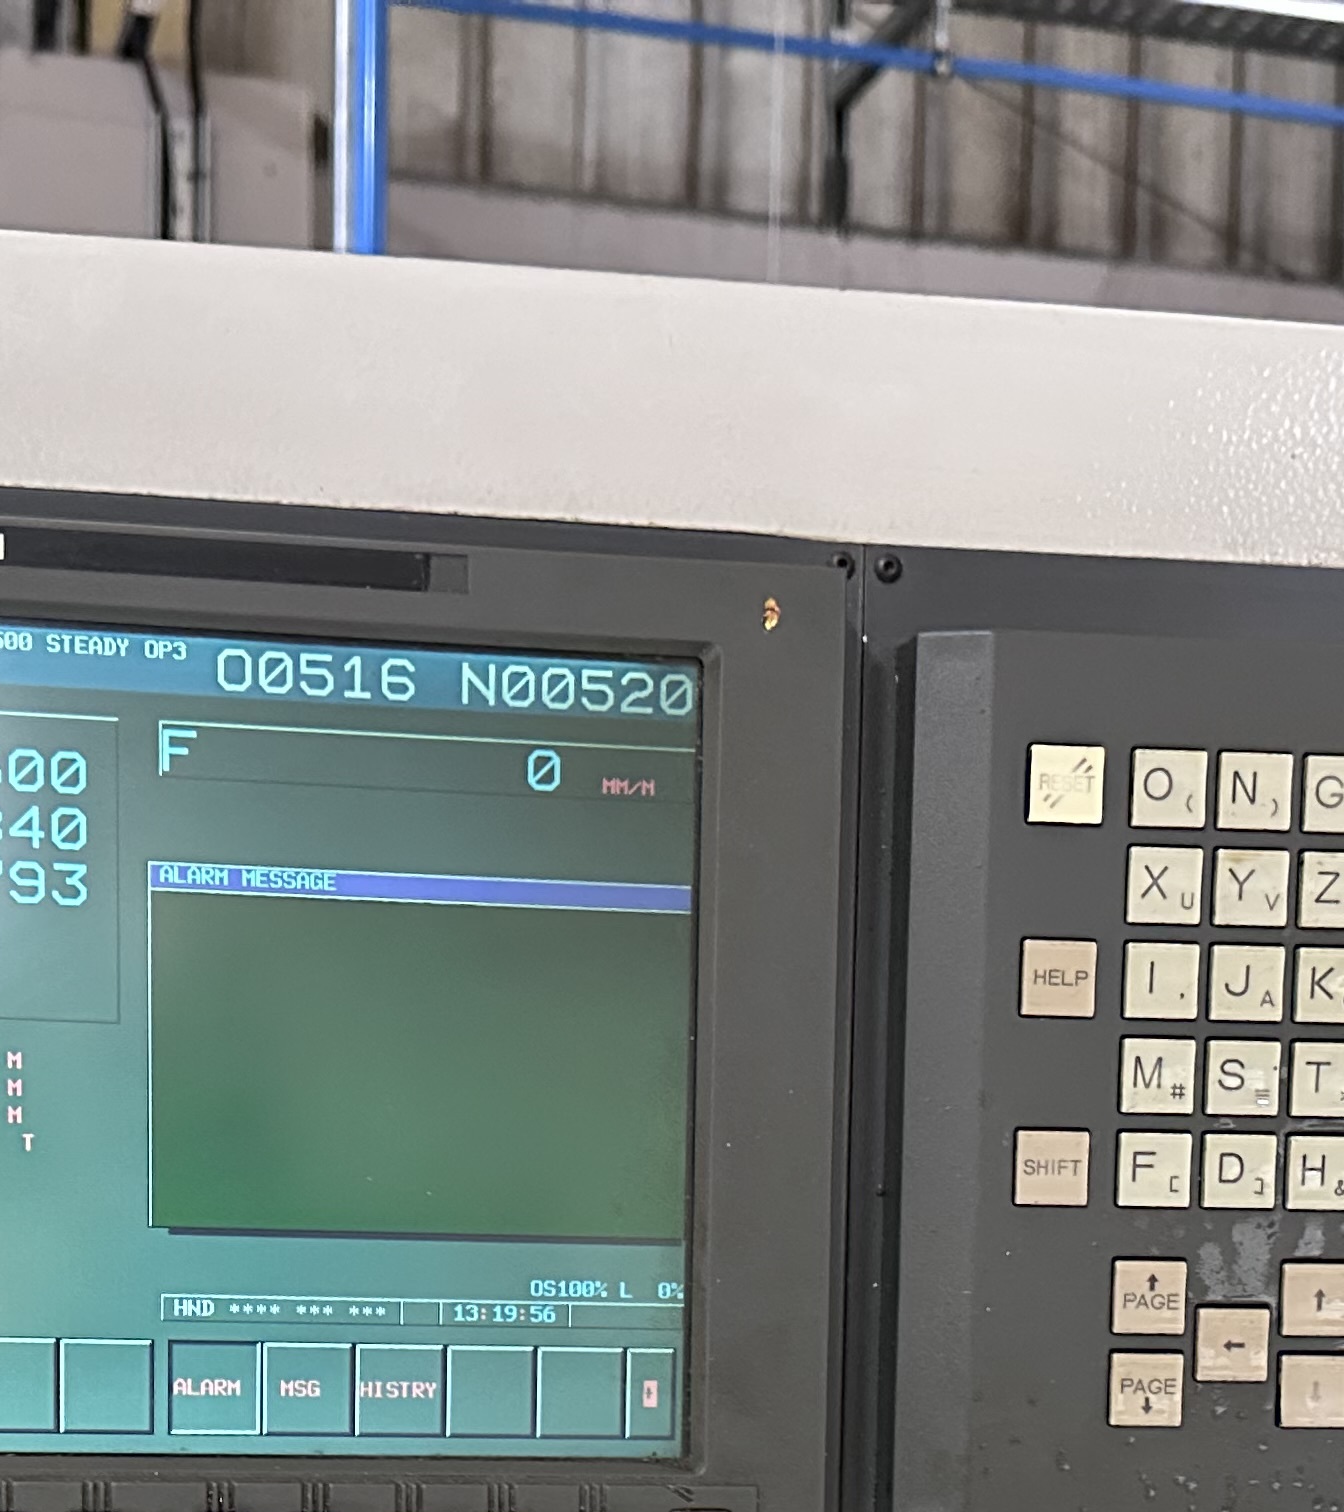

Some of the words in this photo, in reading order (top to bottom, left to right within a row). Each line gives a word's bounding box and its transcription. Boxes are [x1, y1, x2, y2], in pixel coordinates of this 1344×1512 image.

[46, 633, 129, 658] STEADY
[144, 639, 187, 661] OP3
[461, 661, 693, 716] N00520
[163, 730, 197, 772] F
[527, 748, 561, 792] 0
[603, 777, 655, 797] MM/M
[1143, 767, 1173, 800] O
[1231, 770, 1257, 805] N
[1315, 775, 1344, 810] G
[159, 866, 229, 887] ALARM
[242, 870, 337, 891] MESSAGE
[1140, 865, 1168, 900] X
[1228, 868, 1255, 901] Y
[1314, 871, 1340, 904] Z
[1181, 892, 1194, 909] U
[1265, 894, 1281, 911] V
[1033, 969, 1089, 987] HELP
[1224, 965, 1250, 997] J
[1309, 966, 1335, 1000] K
[1260, 990, 1275, 1008] A
[8, 1052, 22, 1069] M
[1132, 1056, 1163, 1090] M
[8, 1079, 22, 1096] M
[1218, 1058, 1245, 1091] S
[1305, 1061, 1331, 1093] T
[8, 1106, 22, 1123] M
[23, 1134, 34, 1151] T
[1023, 1158, 1082, 1177] SHIFT
[1131, 1151, 1157, 1184] F
[1218, 1152, 1244, 1184] D
[1300, 1154, 1326, 1187] H
[530, 1279, 608, 1299] OS100%
[620, 1282, 632, 1299] L
[1122, 1293, 1180, 1311] PAGE
[173, 1298, 215, 1318] HND
[454, 1303, 556, 1325] 13:19:56
[172, 1377, 242, 1397] ALARM
[279, 1379, 321, 1399] MSG
[359, 1380, 437, 1401] HISTRY
[1120, 1377, 1177, 1395] PAGE
